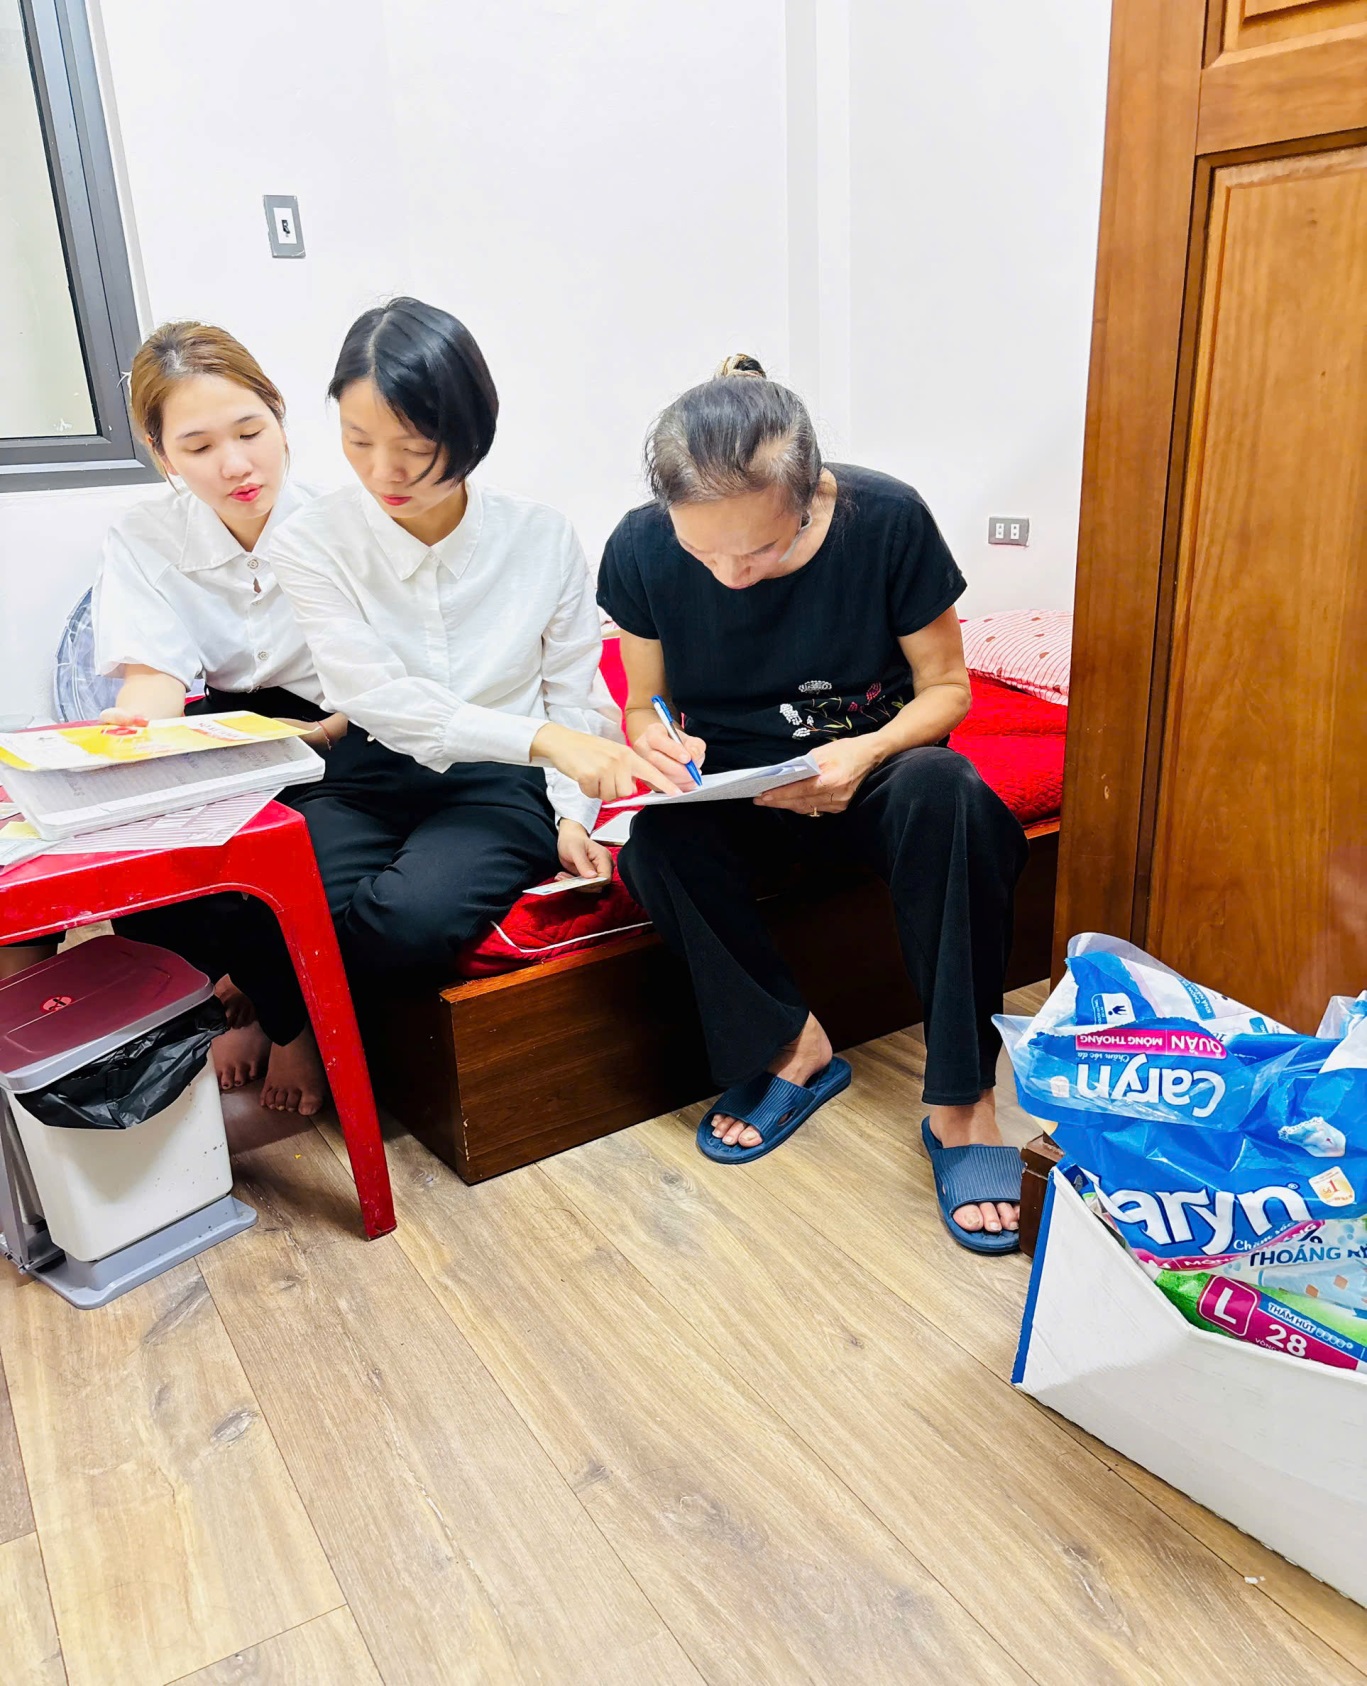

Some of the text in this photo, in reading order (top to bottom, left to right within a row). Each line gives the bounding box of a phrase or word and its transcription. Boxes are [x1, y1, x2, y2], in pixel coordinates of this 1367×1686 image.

[1076, 1052, 1226, 1118] Caryn
[1250, 1243, 1341, 1268] THOÁNG
[1213, 1286, 1237, 1325] L
[1265, 1323, 1308, 1357] 28
[1294, 1316, 1315, 1333] HÚT
